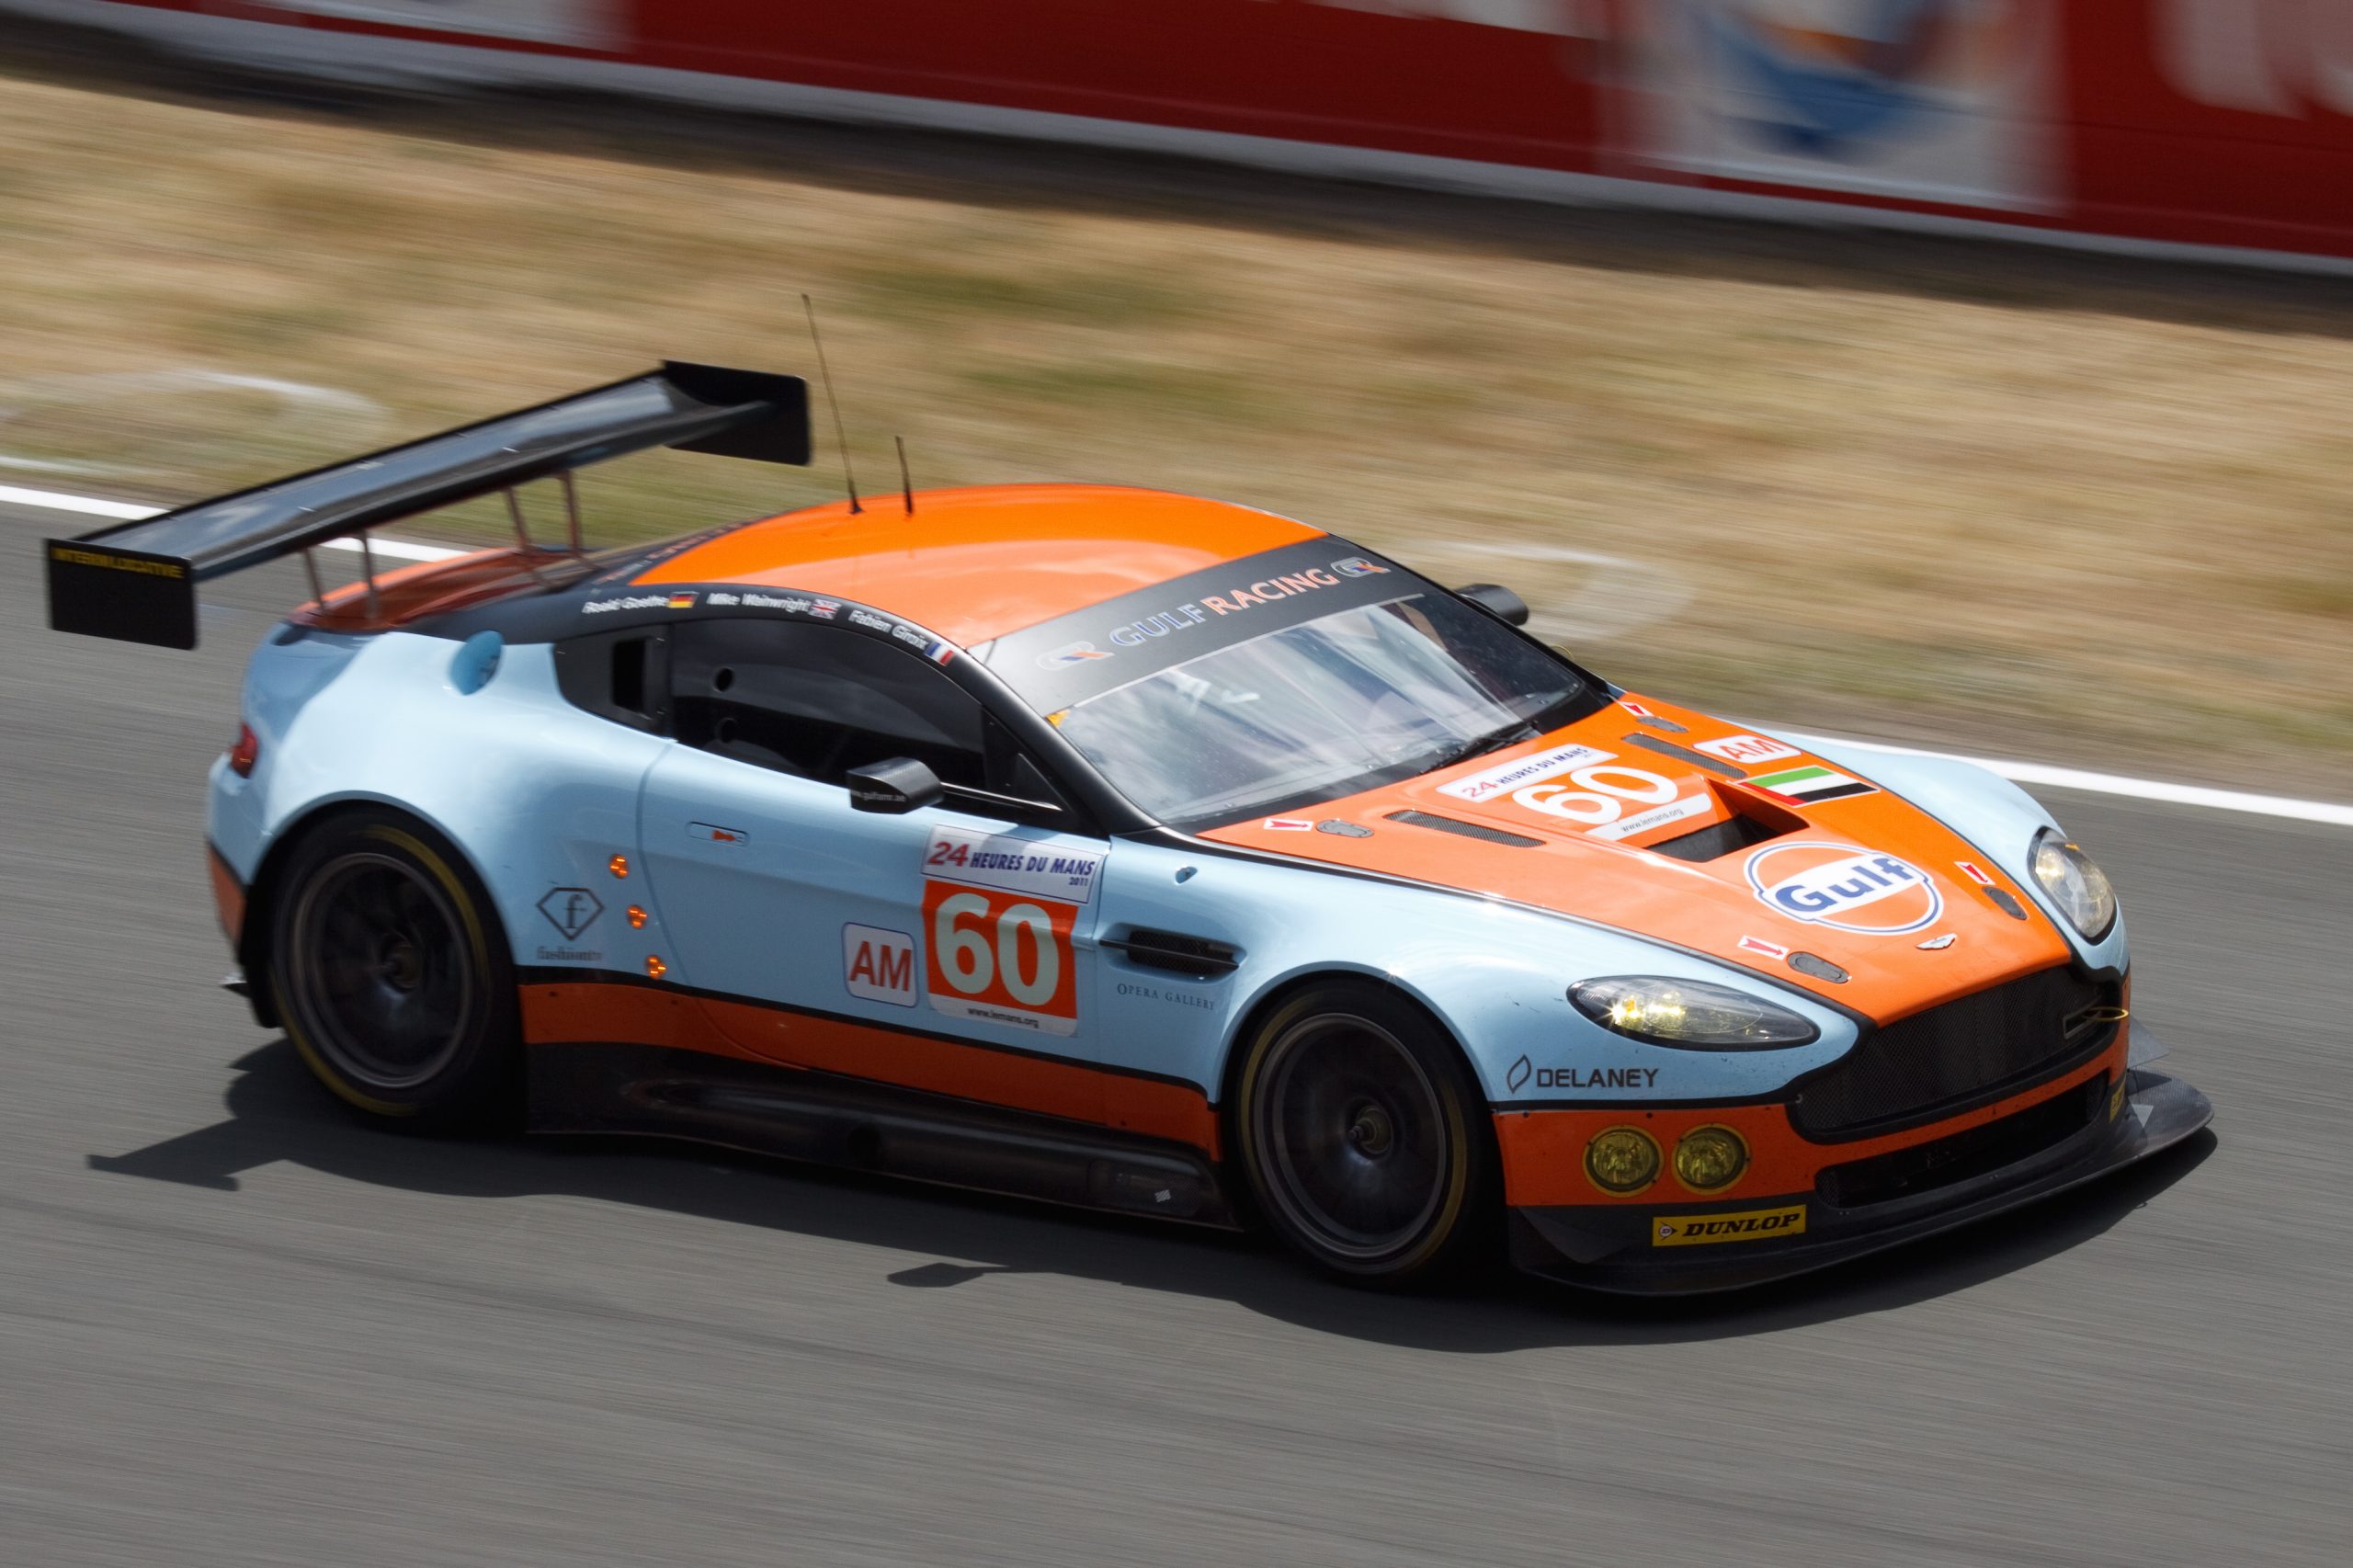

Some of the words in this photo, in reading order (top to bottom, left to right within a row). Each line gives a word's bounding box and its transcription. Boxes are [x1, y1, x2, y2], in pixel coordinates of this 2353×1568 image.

[1108, 604, 1206, 647] GULF
[1200, 568, 1341, 616] RACING
[1719, 736, 1787, 761] AM
[1461, 781, 1497, 798] 24
[1496, 767, 1540, 785] HEURES
[1536, 759, 1555, 769] DU
[1553, 747, 1588, 762] MANS
[1512, 766, 1678, 824] 60
[1621, 809, 1684, 832] www.lemans.org
[927, 841, 970, 868] 24
[970, 852, 1024, 871] HEURES
[1026, 856, 1049, 872] DU
[1050, 858, 1096, 876] MANS
[1068, 876, 1088, 887] 2011
[1775, 858, 1915, 912] Gulf
[935, 892, 1060, 1006] 60
[847, 940, 912, 993] AM
[1117, 983, 1158, 999] OPERA
[1165, 992, 1215, 1010] GALLERY
[967, 1007, 1040, 1028] www.lemans.org
[1537, 1068, 1659, 1088] DELANEY
[1682, 1213, 1801, 1237] DUNLOP
